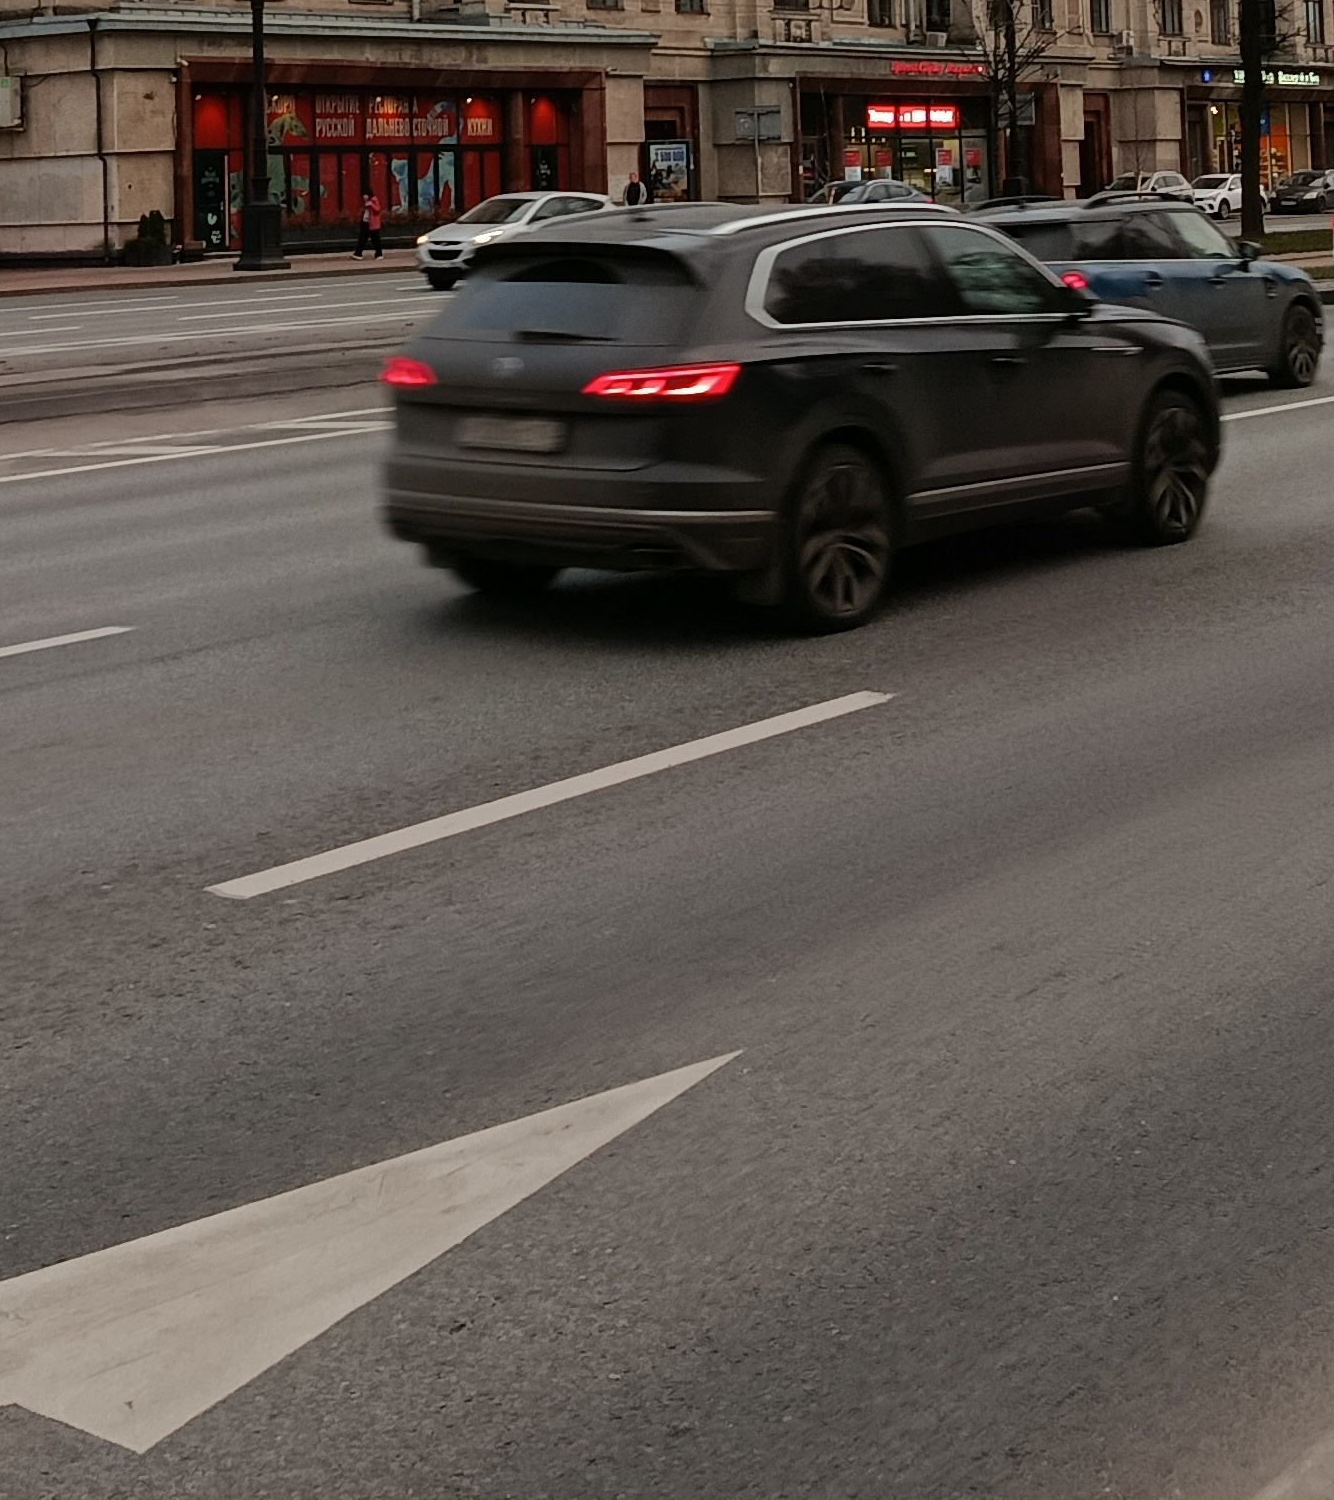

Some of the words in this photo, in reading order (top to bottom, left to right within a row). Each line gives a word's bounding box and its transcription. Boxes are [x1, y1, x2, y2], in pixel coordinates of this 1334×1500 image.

[316, 94, 360, 114] ОТКРЫТИЕ
[316, 115, 354, 137] РУССКОЙ
[467, 118, 493, 136] КУХНИ
